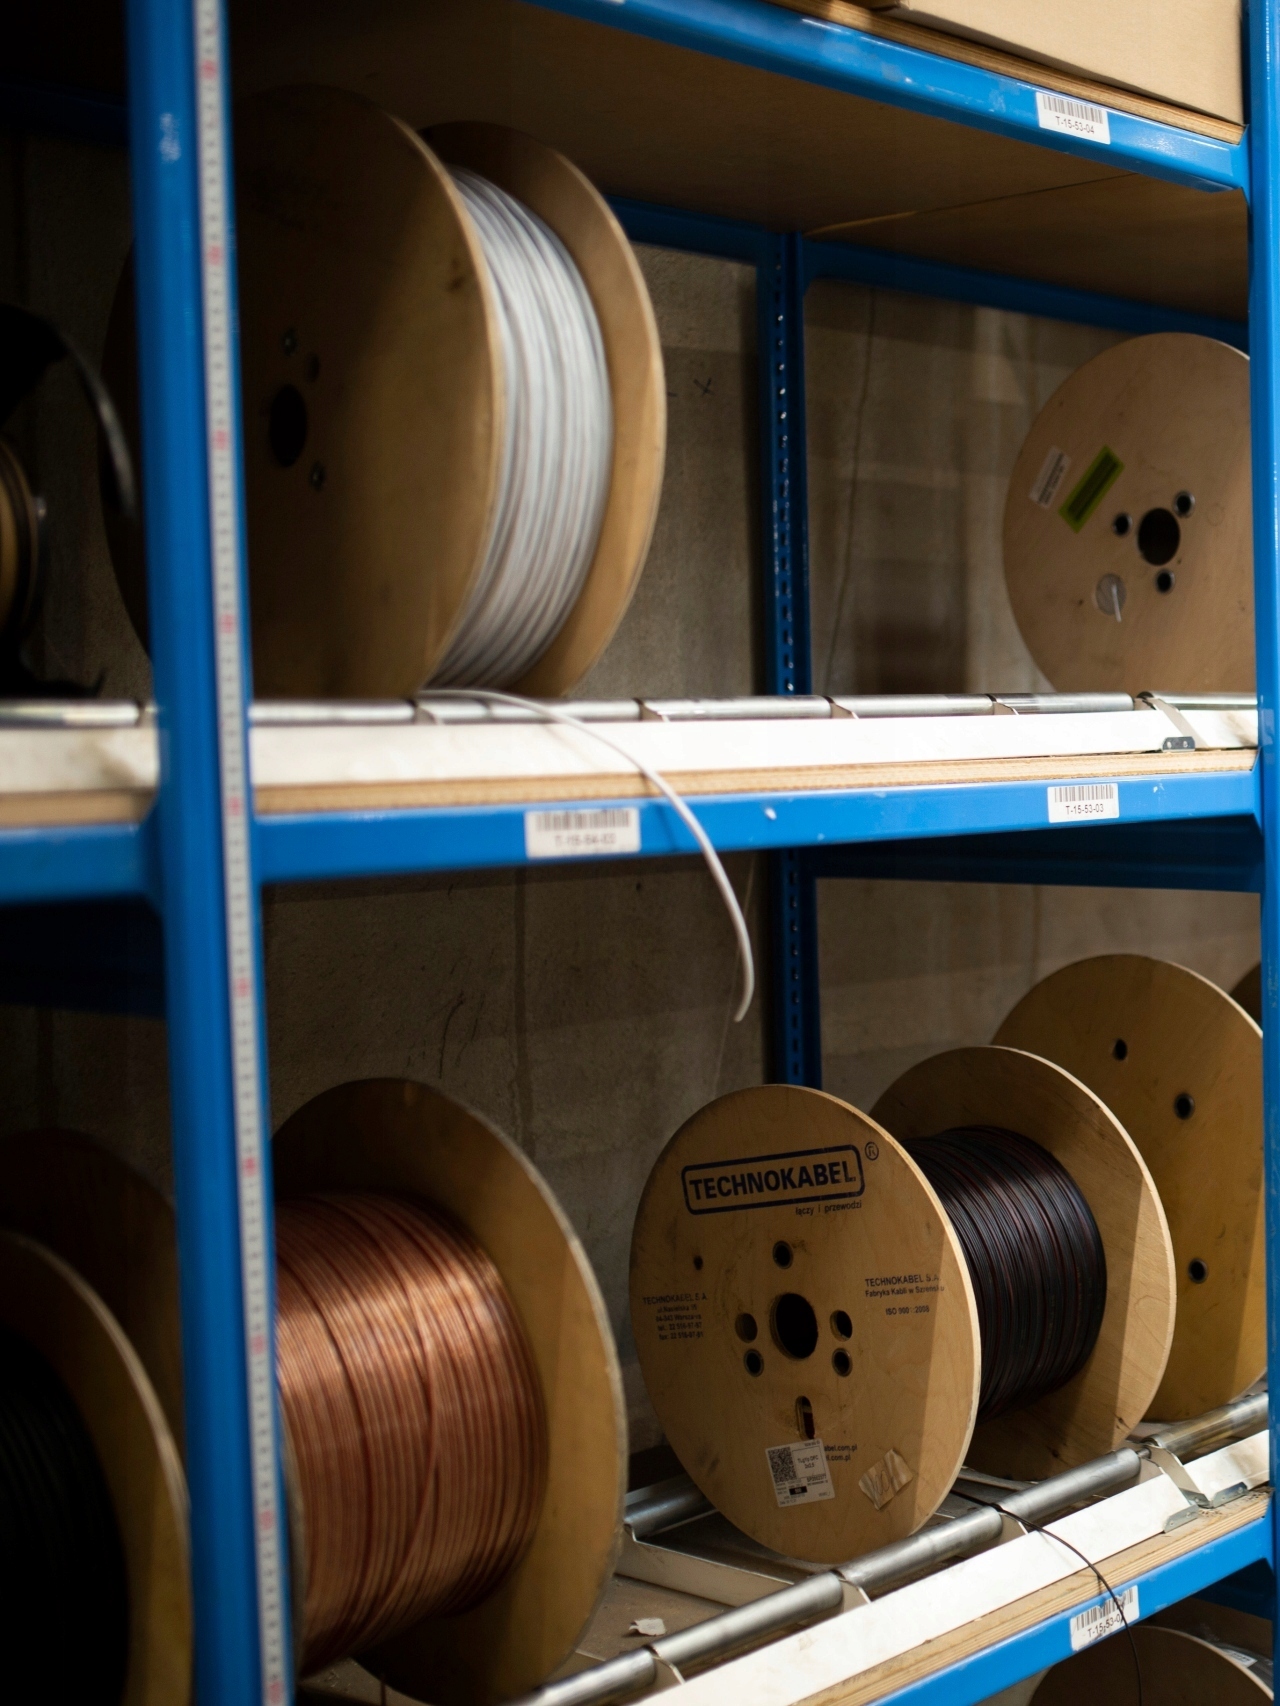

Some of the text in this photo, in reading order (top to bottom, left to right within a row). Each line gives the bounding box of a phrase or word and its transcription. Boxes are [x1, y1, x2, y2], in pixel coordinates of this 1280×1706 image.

[1055, 116, 1095, 134] T-15-53-04
[1065, 804, 1104, 815] T-15-53-03
[689, 1161, 856, 1200] TECHNOKABEL
[796, 1206, 814, 1216] łączy
[824, 1201, 862, 1214] przewodzi
[865, 1274, 924, 1287] TECHNOKABEL
[865, 1289, 890, 1298] Fabryka
[891, 1287, 907, 1295] Kabli
[885, 1307, 897, 1315] ISO
[1088, 1613, 1124, 1637] T-15-53-0
